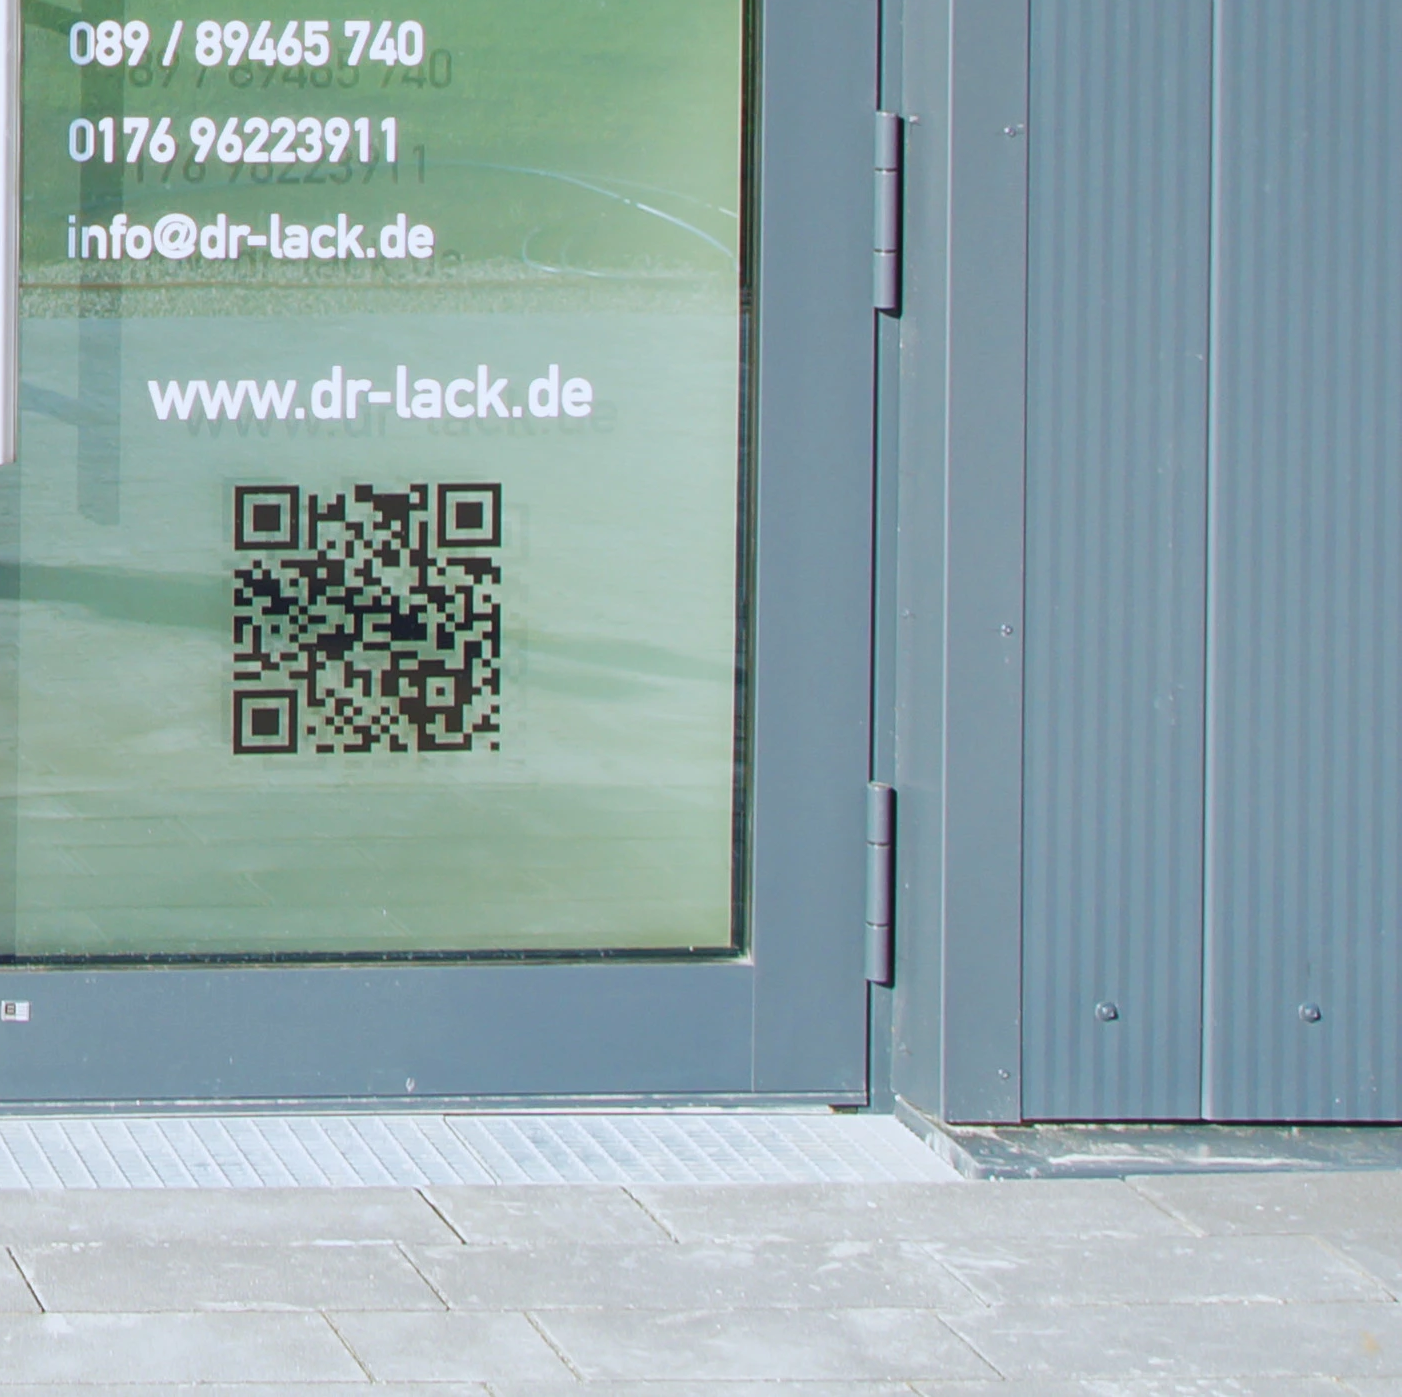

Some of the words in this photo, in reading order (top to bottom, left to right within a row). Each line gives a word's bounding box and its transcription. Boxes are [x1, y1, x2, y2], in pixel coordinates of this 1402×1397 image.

[68, 20, 150, 67] 089
[195, 20, 330, 67] 89465
[344, 20, 424, 67] 740
[68, 116, 176, 164] 0176
[189, 116, 397, 164] 96223911
[68, 213, 434, 260] info@dr-lack.de
[147, 363, 594, 420] www.dr-lack.de
